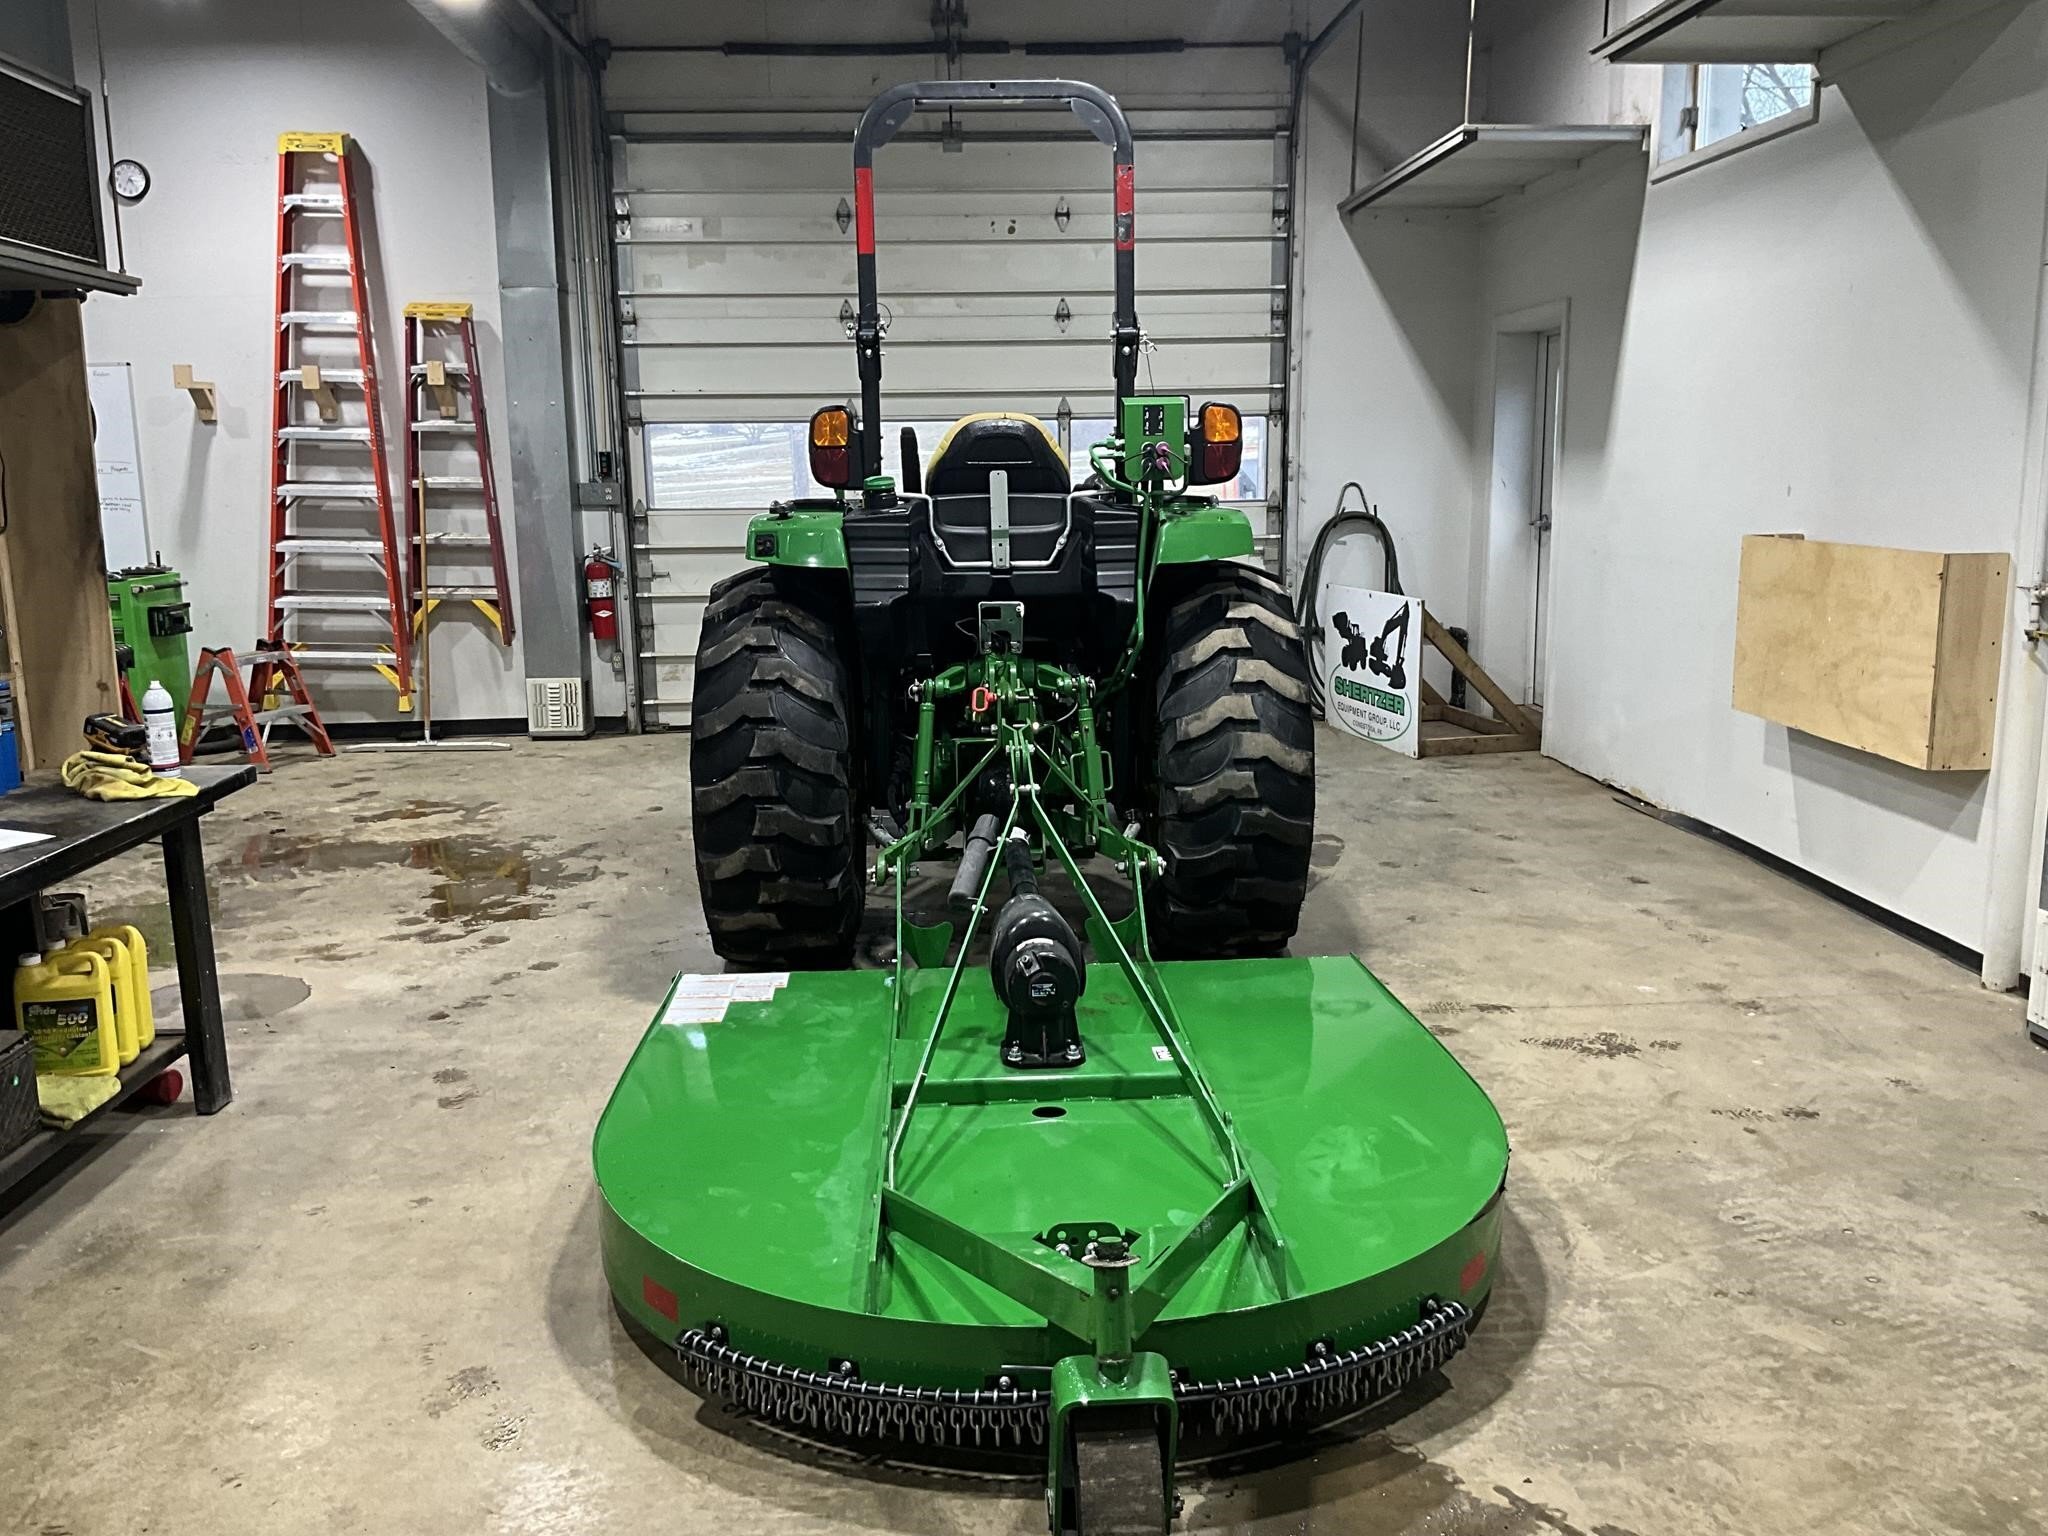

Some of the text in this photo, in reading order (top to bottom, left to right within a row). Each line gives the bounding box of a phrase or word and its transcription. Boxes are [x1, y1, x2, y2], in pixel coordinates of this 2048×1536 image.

[1335, 676, 1405, 716] SHERTZER
[1337, 702, 1401, 731] EQUIPMENT GROUP, LLC
[57, 1012, 89, 1026] 500
